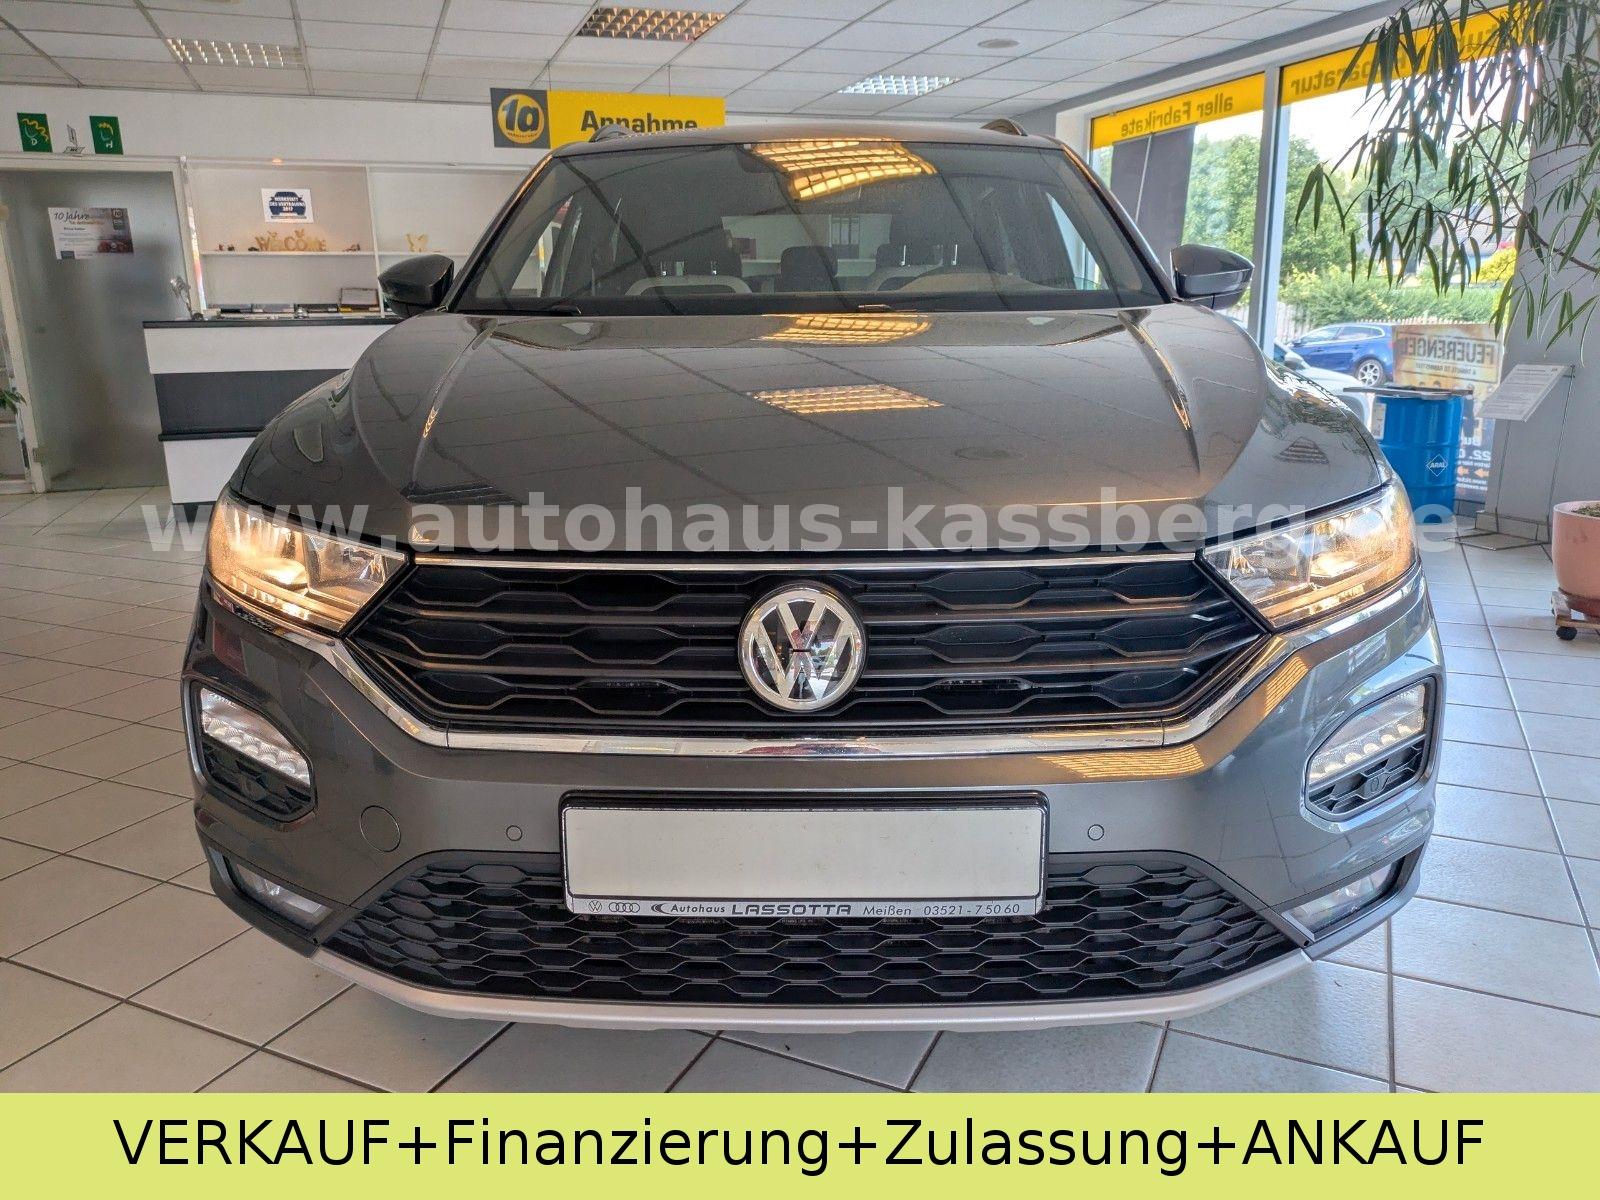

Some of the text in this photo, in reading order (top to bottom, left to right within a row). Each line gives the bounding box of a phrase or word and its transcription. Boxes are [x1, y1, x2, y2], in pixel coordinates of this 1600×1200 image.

[580, 110, 698, 133] Annahme
[670, 903, 726, 914] Autohaus
[731, 904, 852, 916] LASSOTTA
[862, 904, 912, 917] Meißen
